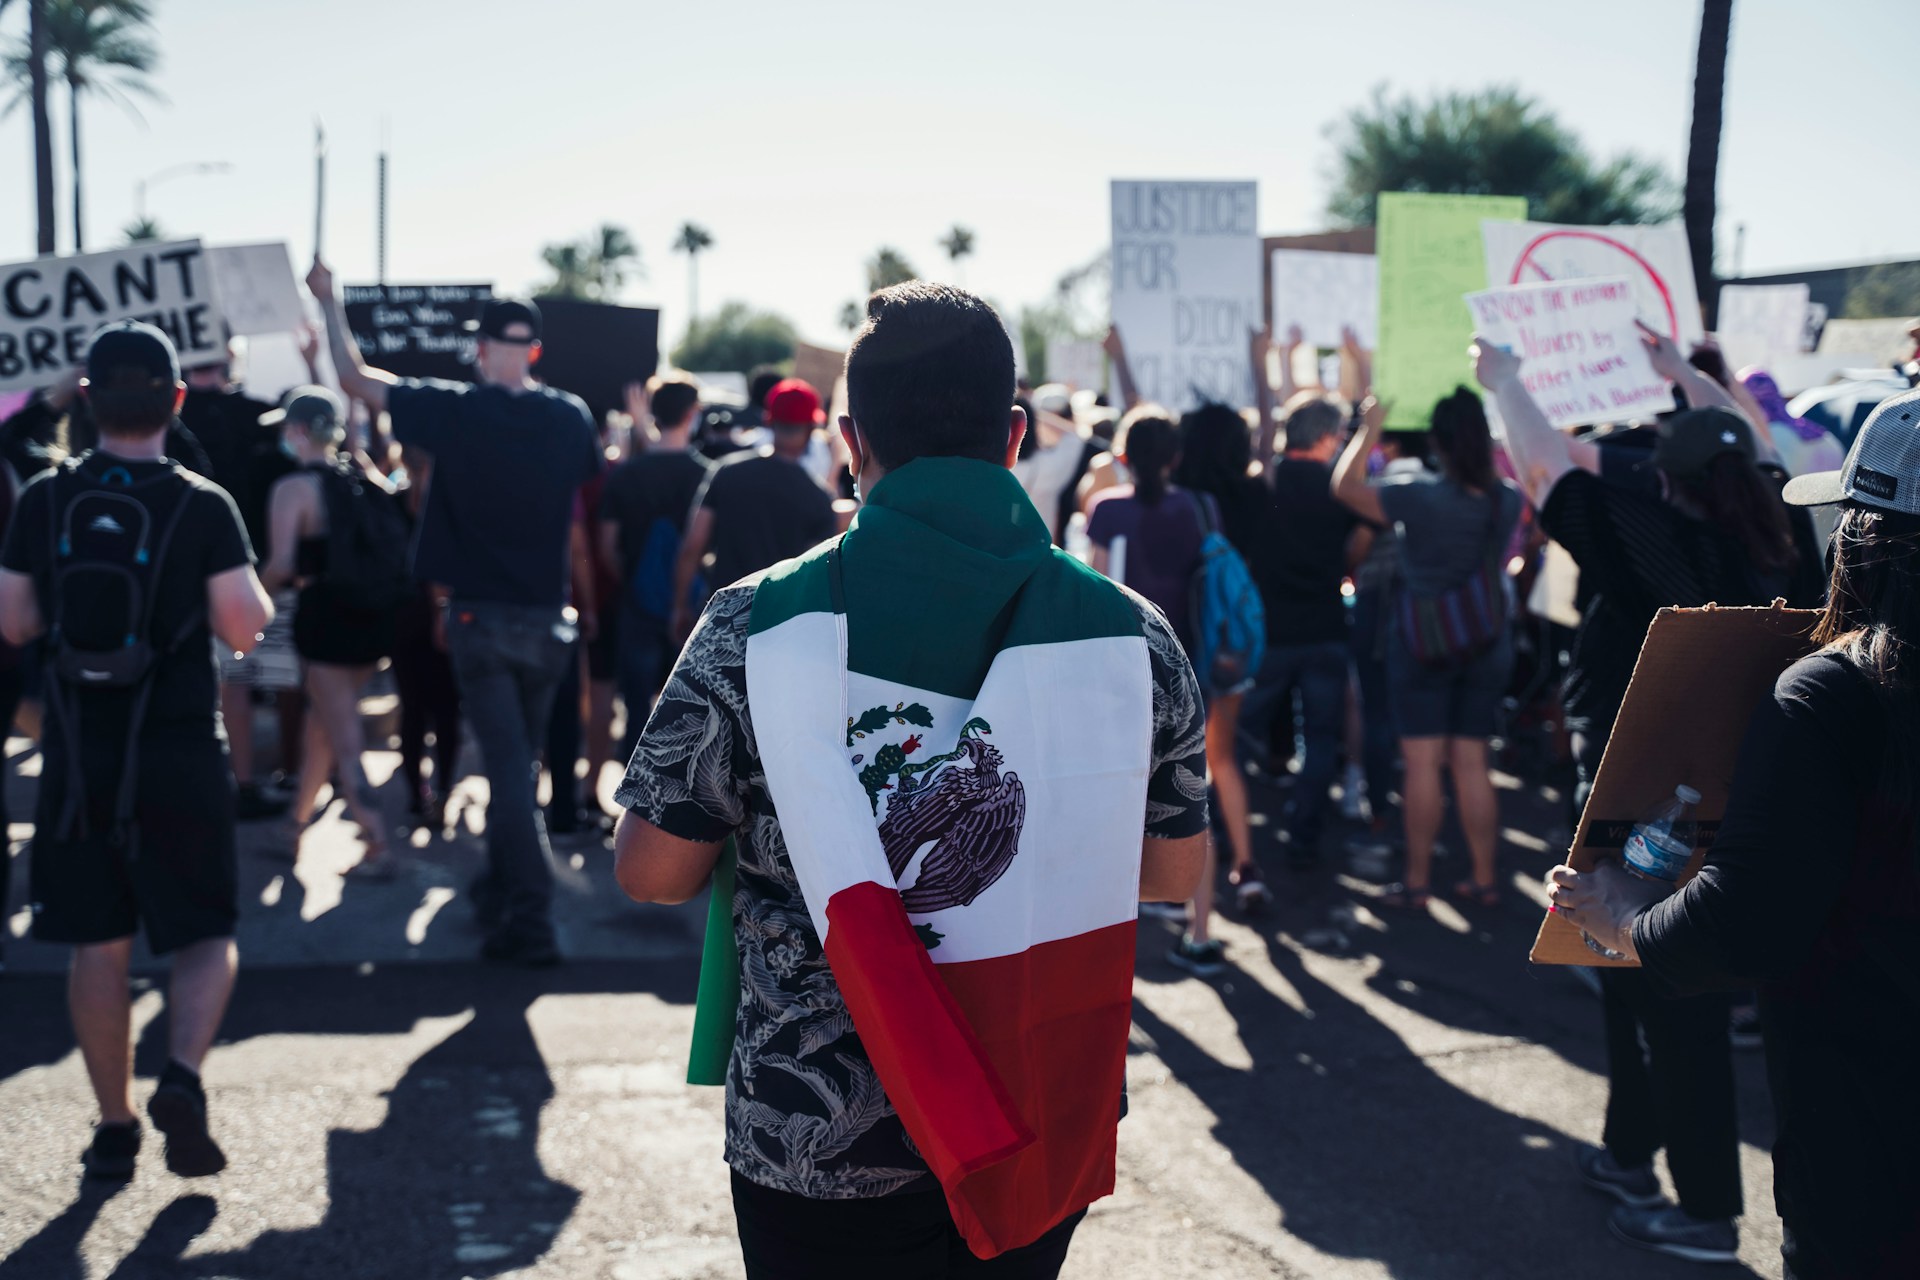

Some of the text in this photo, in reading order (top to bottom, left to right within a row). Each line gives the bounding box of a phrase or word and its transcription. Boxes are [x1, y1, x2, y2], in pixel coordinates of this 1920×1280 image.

[1116, 185, 1250, 235] JUSTICE
[3, 246, 199, 320] CANT
[1116, 240, 1178, 290] FOR
[1477, 293, 1534, 323] KNOW
[0, 303, 213, 378] BREHE
